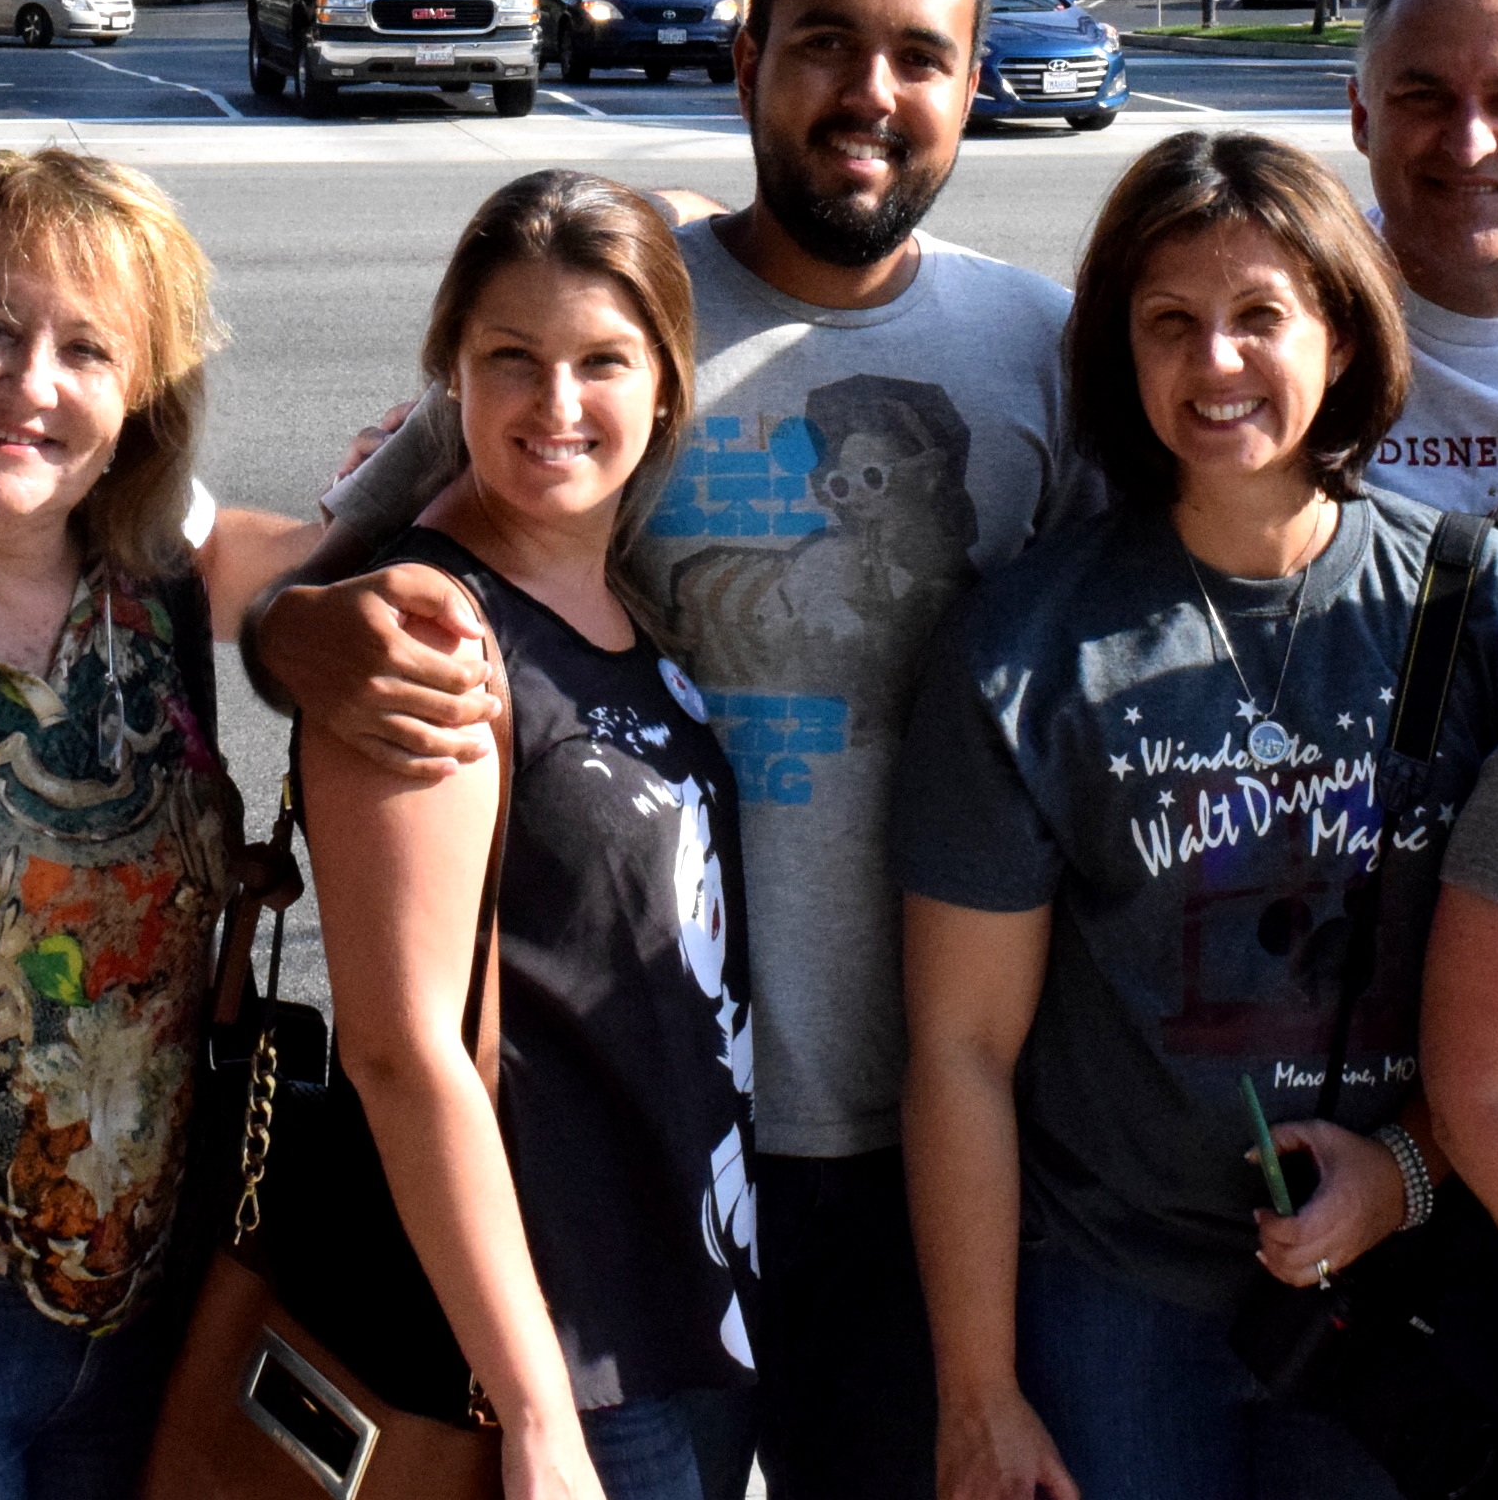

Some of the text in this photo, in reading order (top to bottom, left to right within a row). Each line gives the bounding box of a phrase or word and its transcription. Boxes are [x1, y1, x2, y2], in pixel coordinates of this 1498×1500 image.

[412, 8, 456, 20] GMC
[1141, 732, 1323, 778] Windo to
[1131, 716, 1377, 878] Walt Disney'
[1274, 1055, 1417, 1089] Marcine, MO
